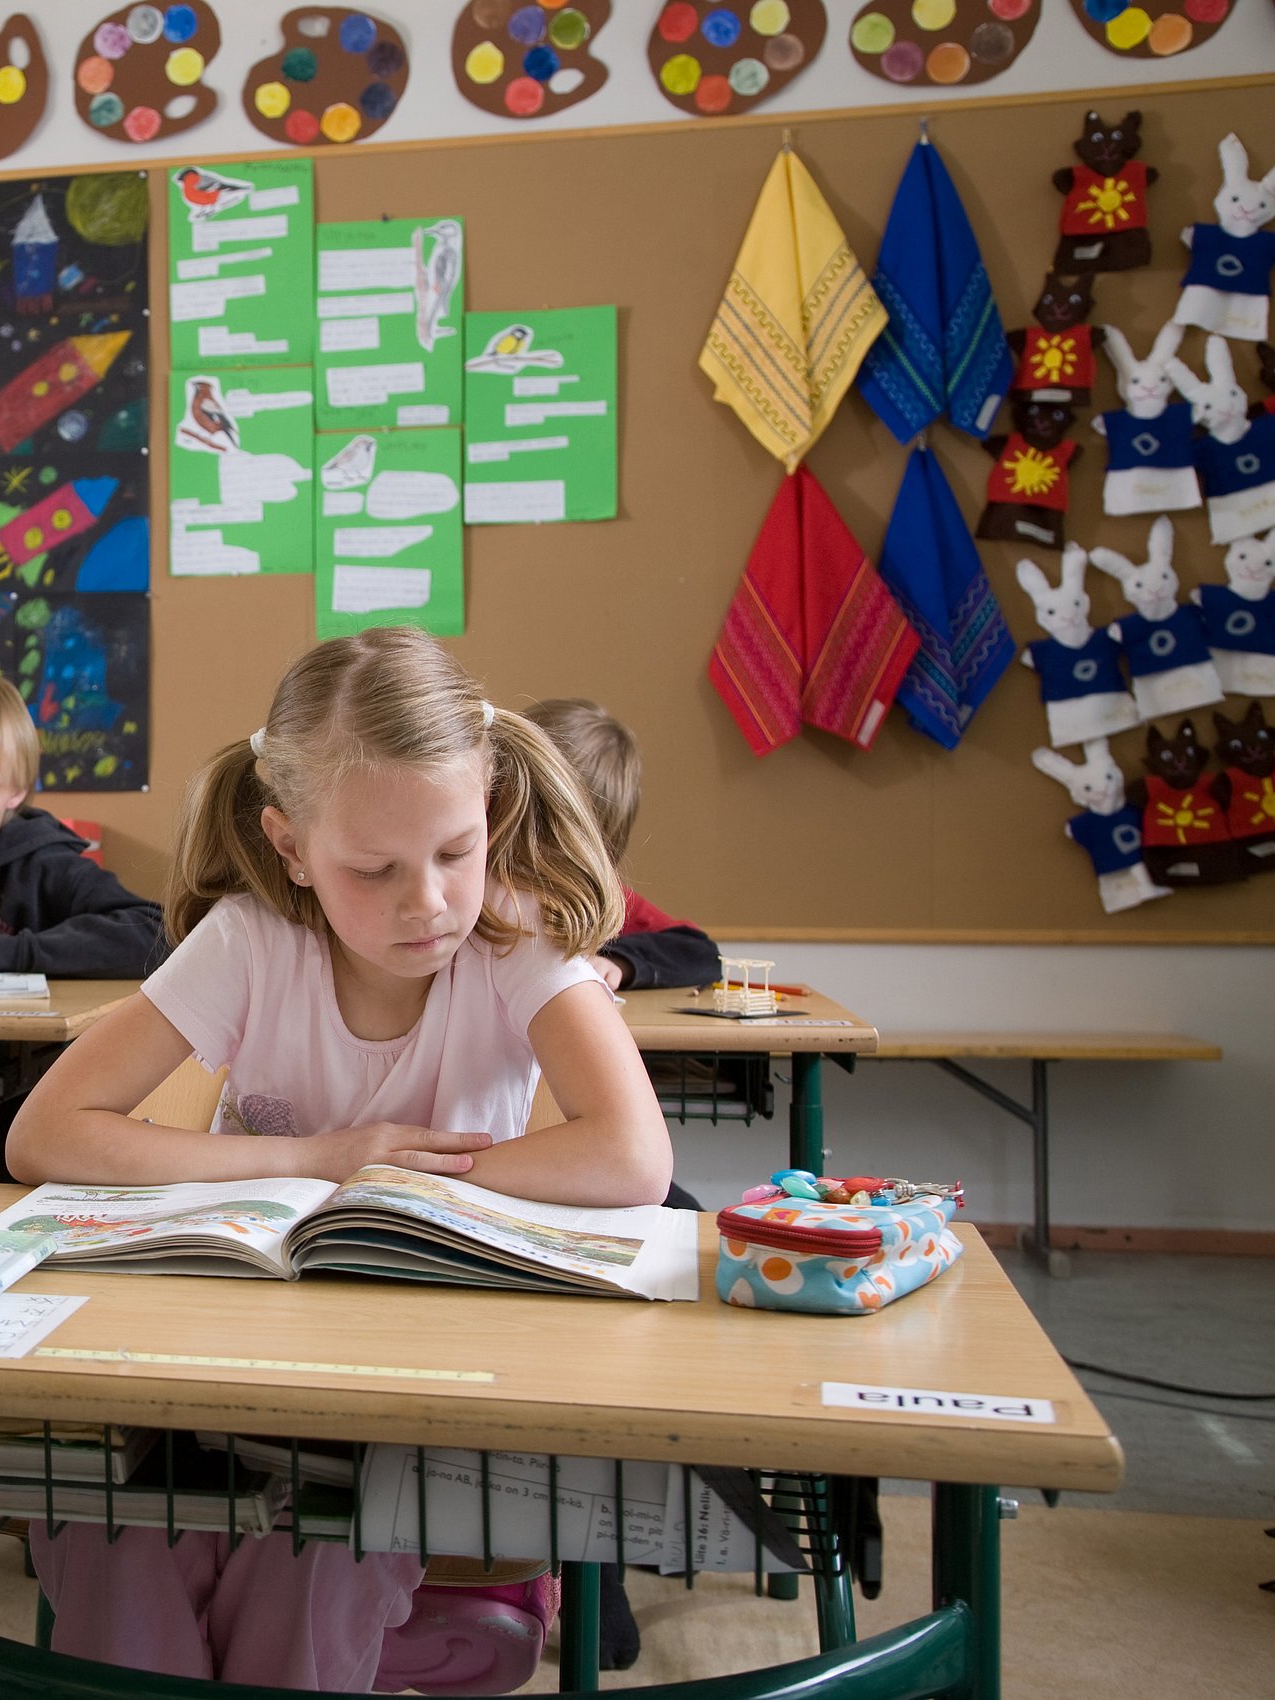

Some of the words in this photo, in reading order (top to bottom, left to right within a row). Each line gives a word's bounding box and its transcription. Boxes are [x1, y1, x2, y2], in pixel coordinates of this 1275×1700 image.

[857, 1391, 1033, 1417] Paula
[426, 1467, 453, 1481] ja-na
[505, 1486, 519, 1495] on
[523, 1488, 529, 1497] 3
[533, 1492, 549, 1501] cm
[601, 1504, 612, 1514] b.
[599, 1520, 613, 1528] on
[694, 1544, 706, 1564] Liite
